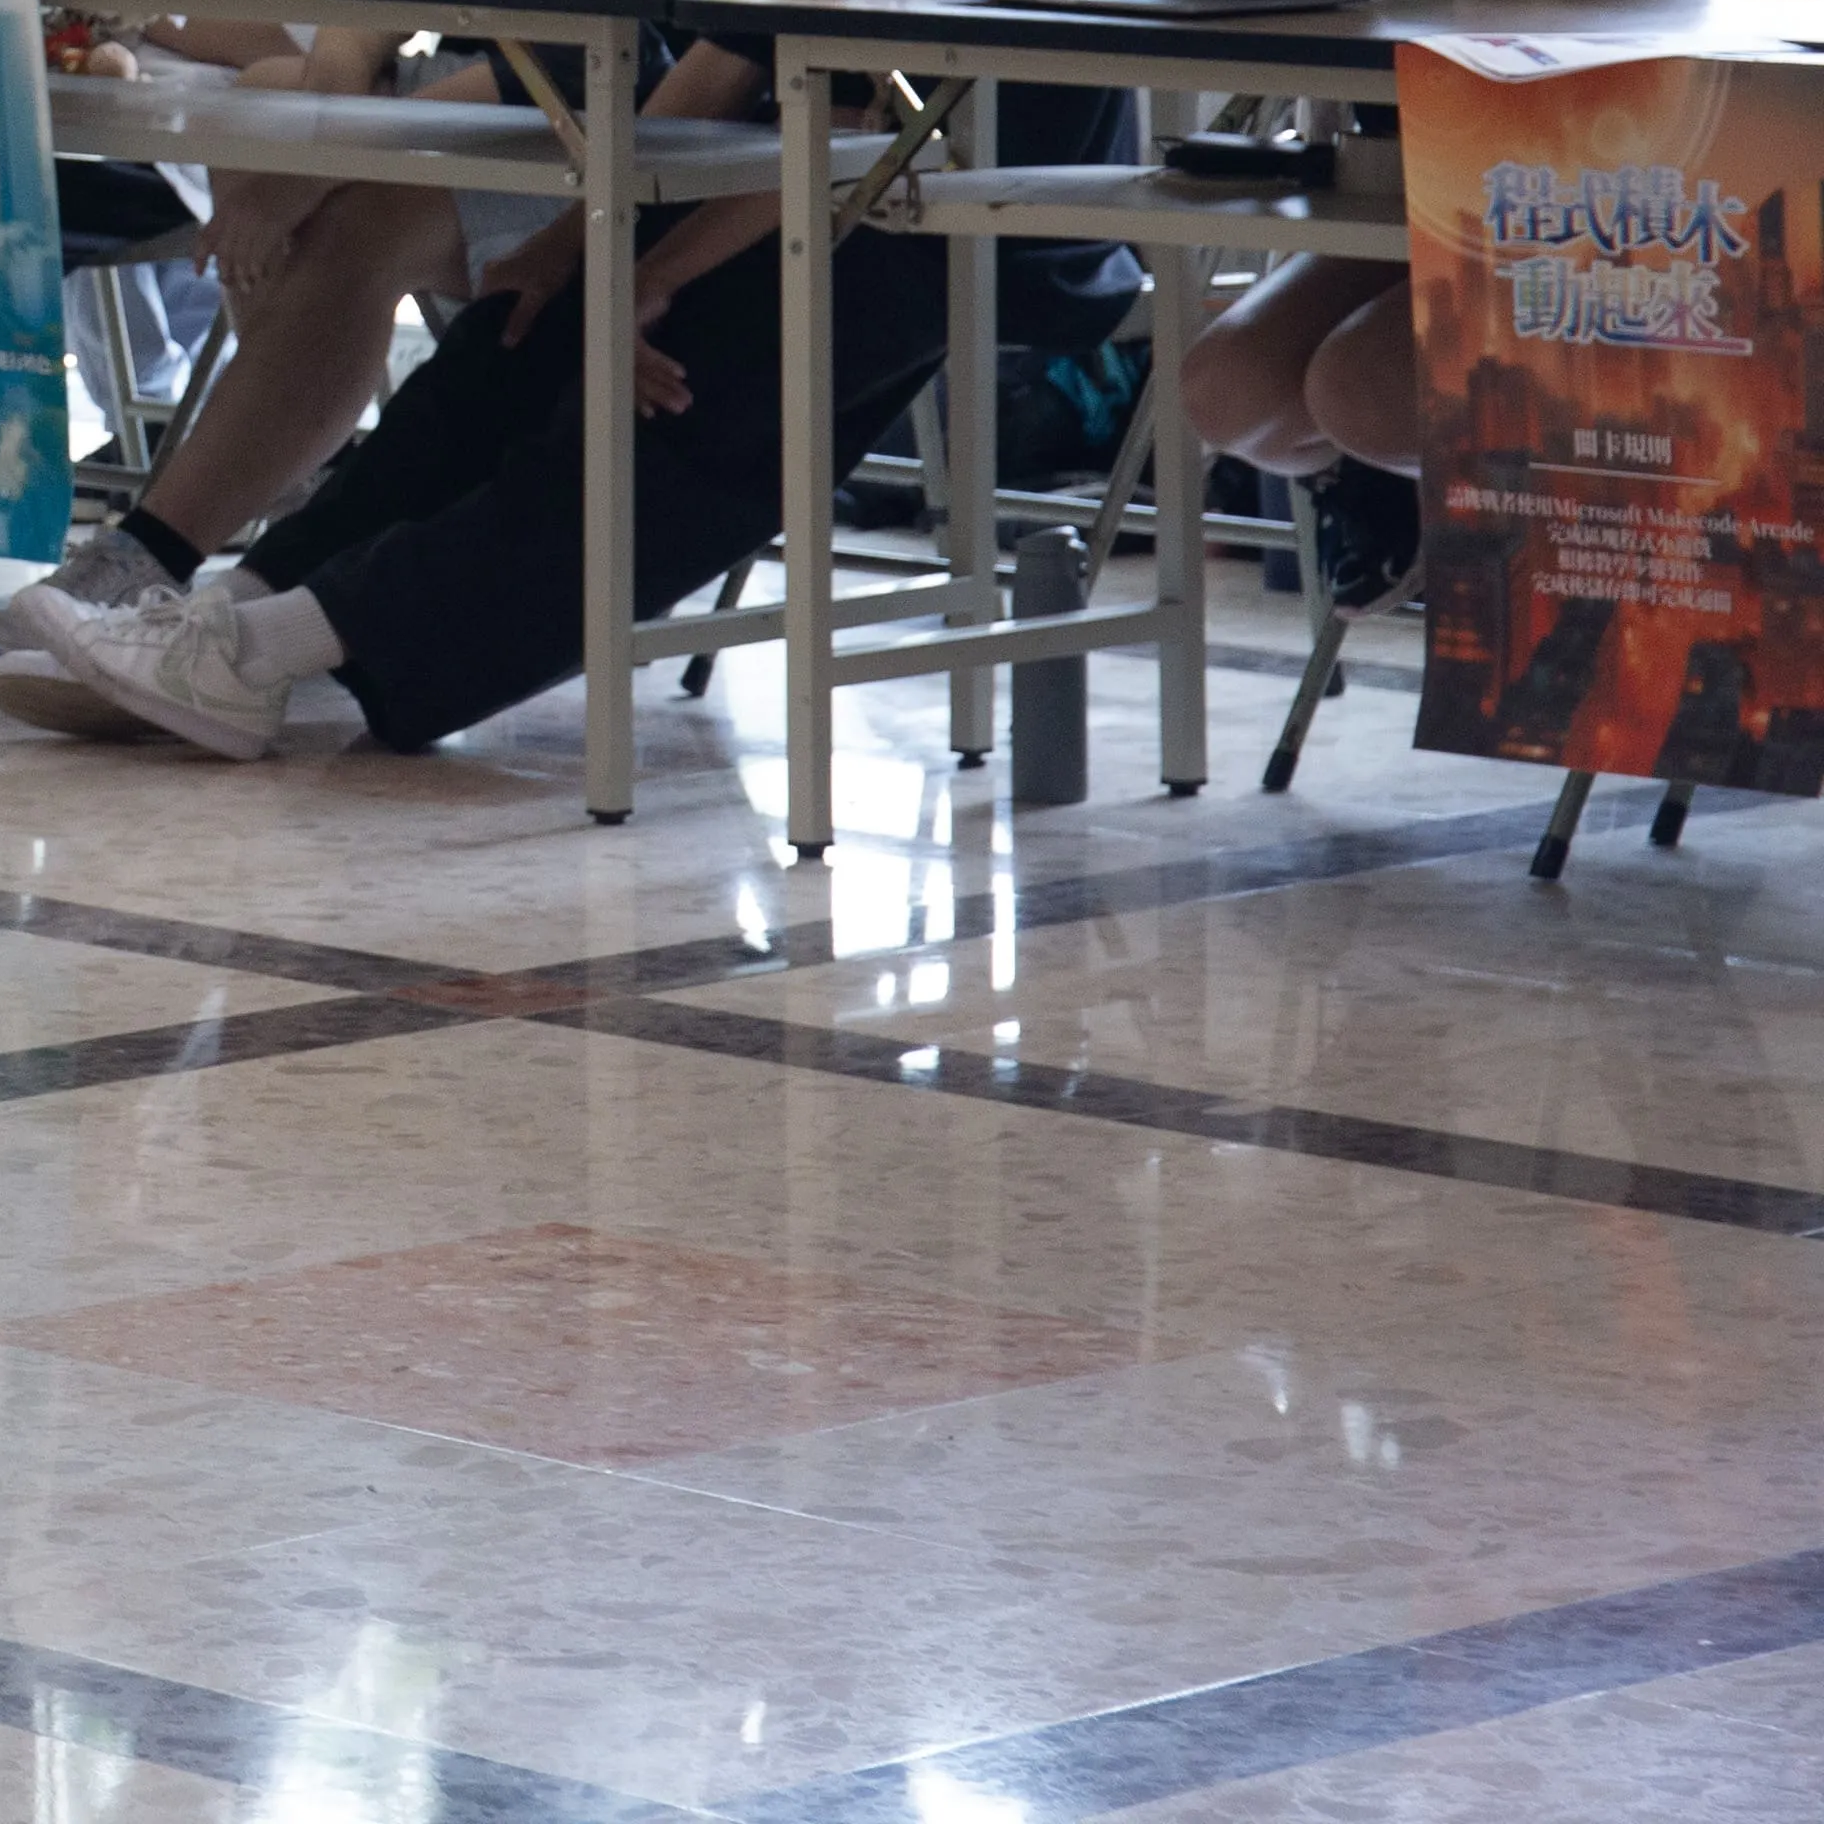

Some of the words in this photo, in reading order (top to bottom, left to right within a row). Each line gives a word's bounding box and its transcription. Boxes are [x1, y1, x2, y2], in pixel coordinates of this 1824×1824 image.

[1483, 161, 1749, 265] 程式積木
[1495, 255, 1753, 355] 動起來
[1751, 518, 1815, 544] Arcade
